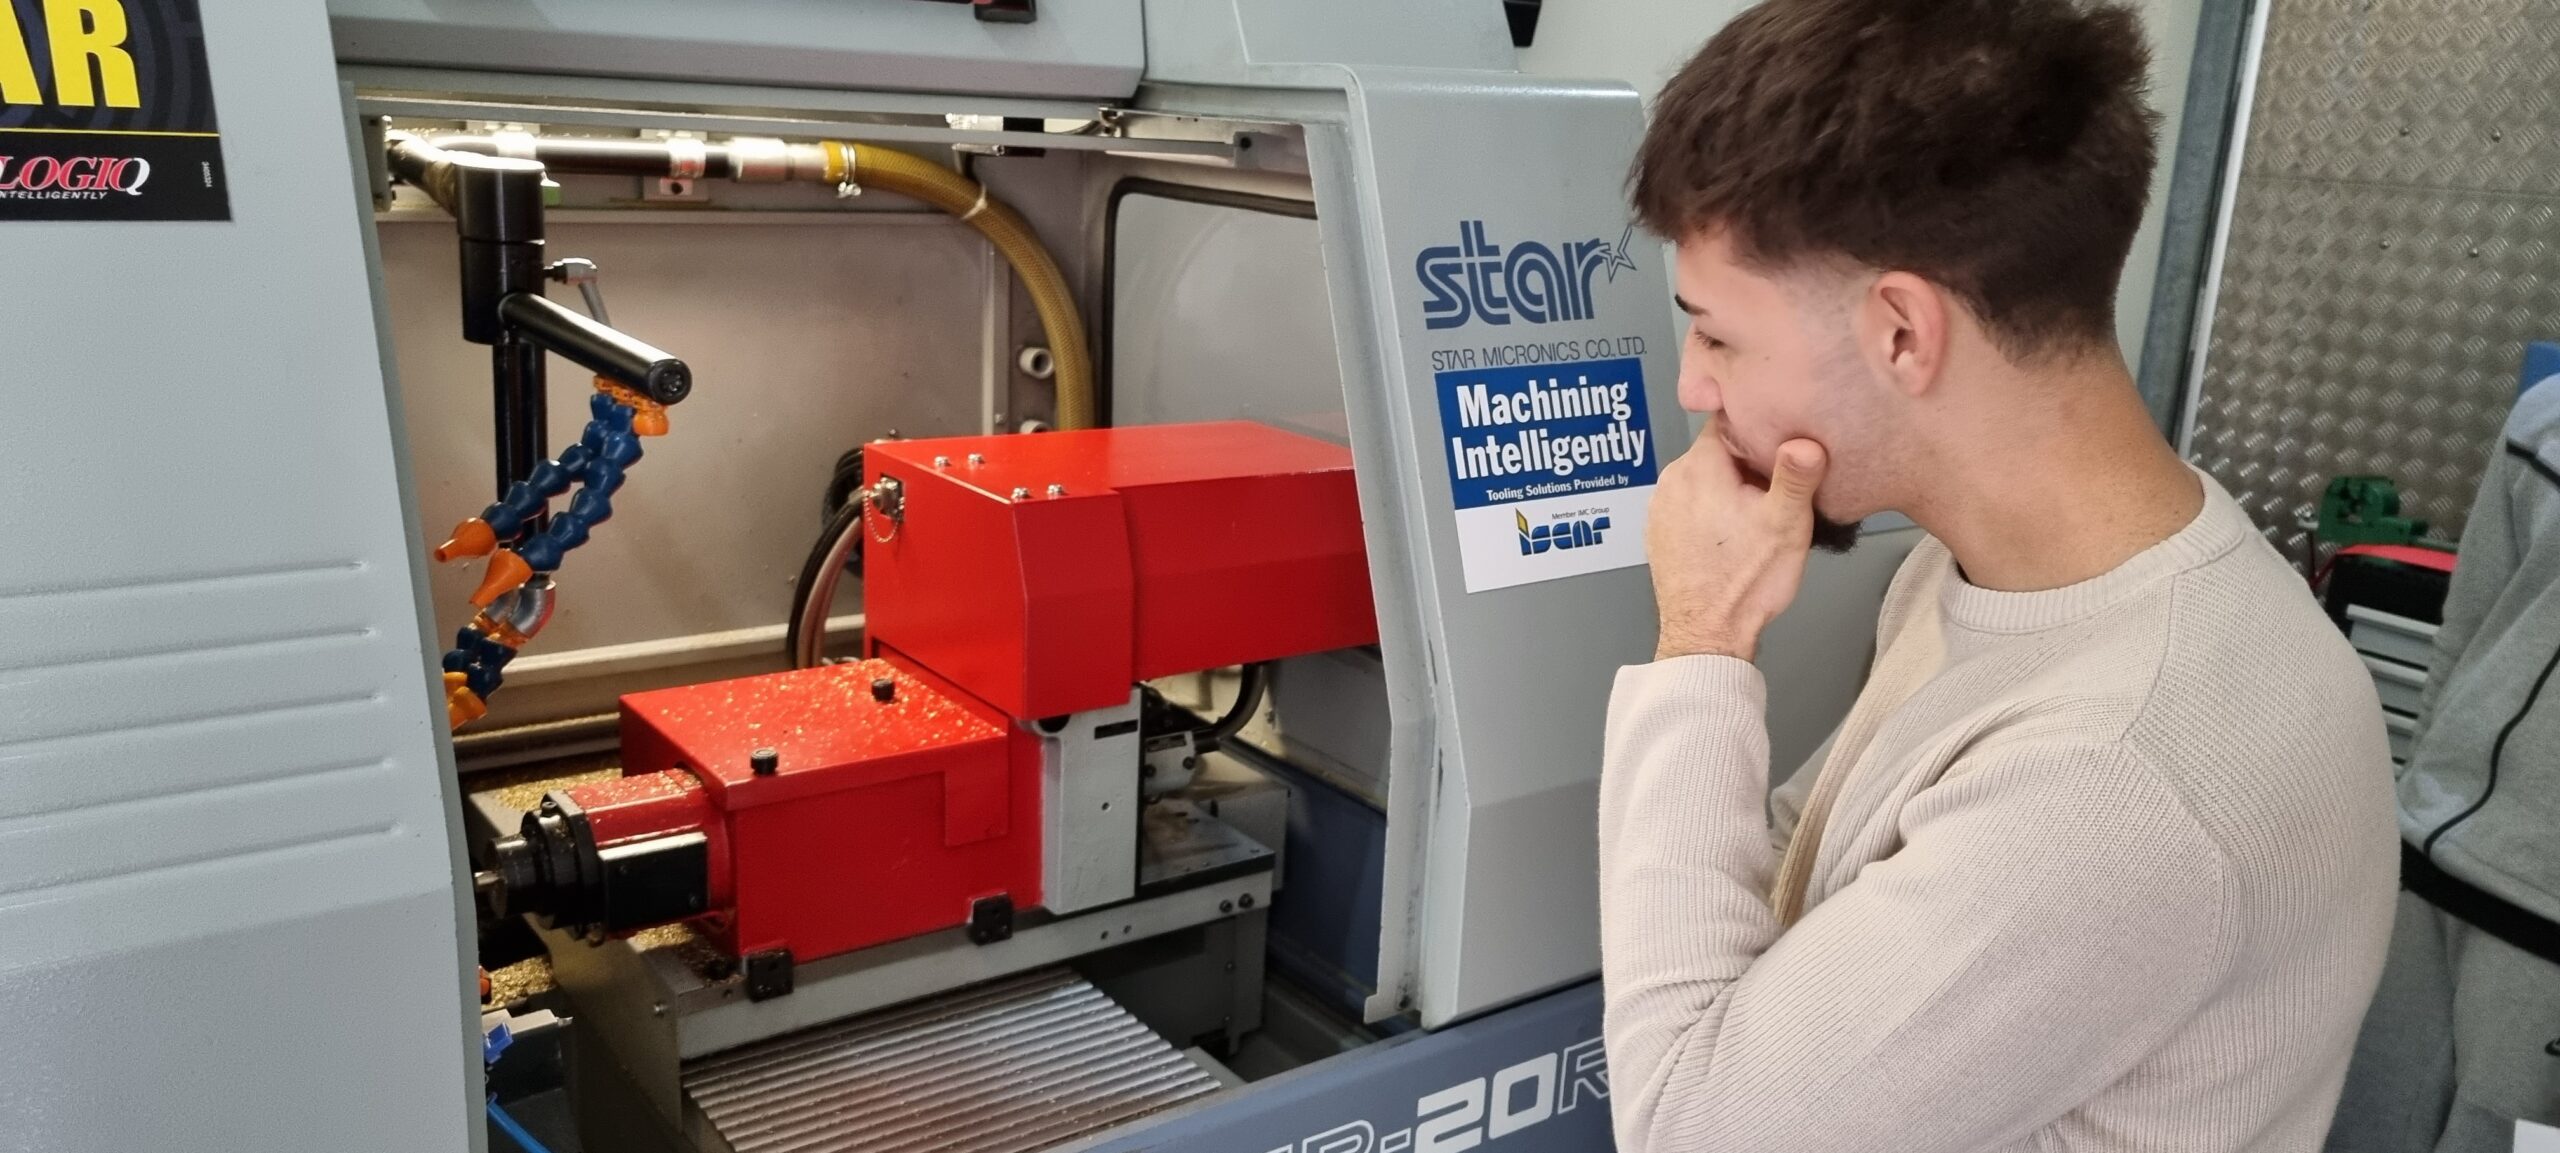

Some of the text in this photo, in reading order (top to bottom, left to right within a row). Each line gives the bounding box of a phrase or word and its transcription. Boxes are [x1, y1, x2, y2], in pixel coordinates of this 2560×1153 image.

[1431, 349, 1477, 371] STAR
[1483, 341, 1581, 366] MICRONICS
[1456, 375, 1632, 429] Machining
[1452, 420, 1646, 480] Intelligently
[1485, 473, 1630, 501] Tooling Solutions Provided by
[1551, 511, 1576, 520] Member
[1590, 506, 1610, 516] Group
